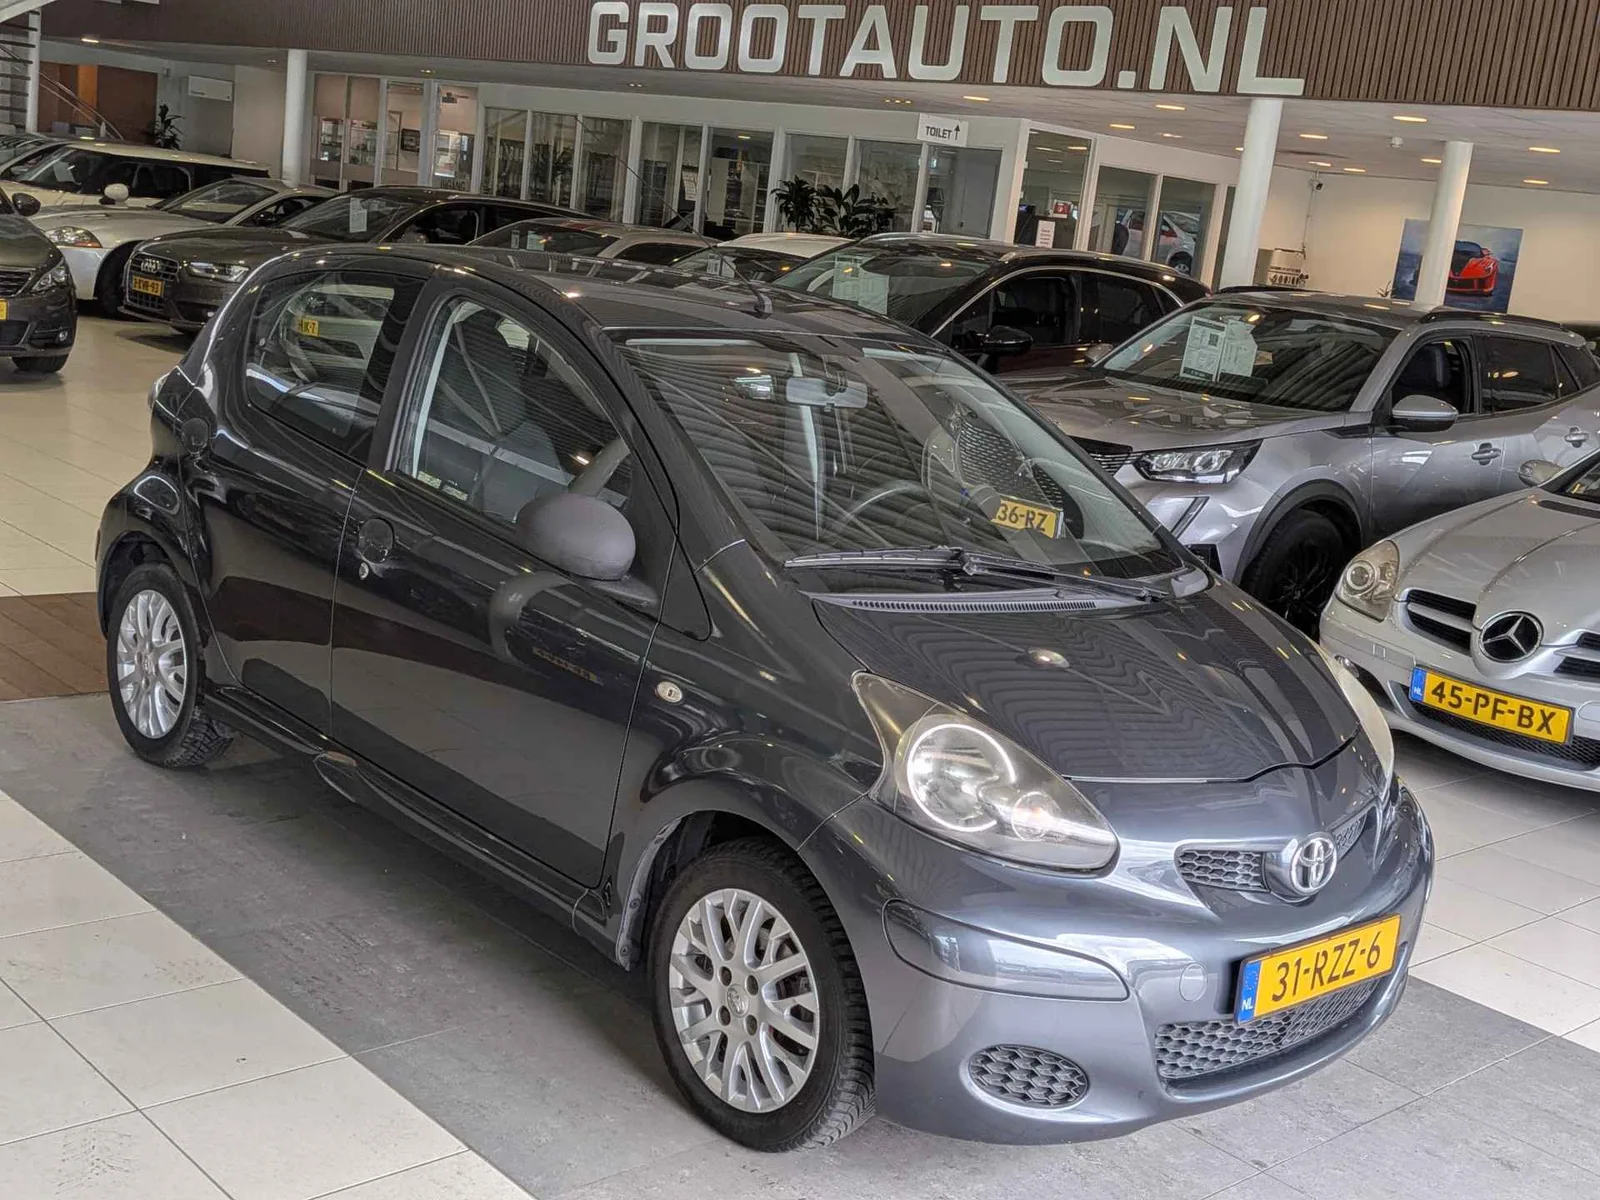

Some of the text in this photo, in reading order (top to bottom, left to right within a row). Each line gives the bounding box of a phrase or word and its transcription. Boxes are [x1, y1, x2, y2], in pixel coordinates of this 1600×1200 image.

[588, 1, 1305, 95] GROOTAUTO.NL
[925, 126, 952, 140] TOILET
[1413, 686, 1423, 697] NL
[1431, 681, 1557, 735] 45-PF-BX
[1271, 931, 1382, 1003] 31-RZZ-6
[1241, 997, 1254, 1012] NL
